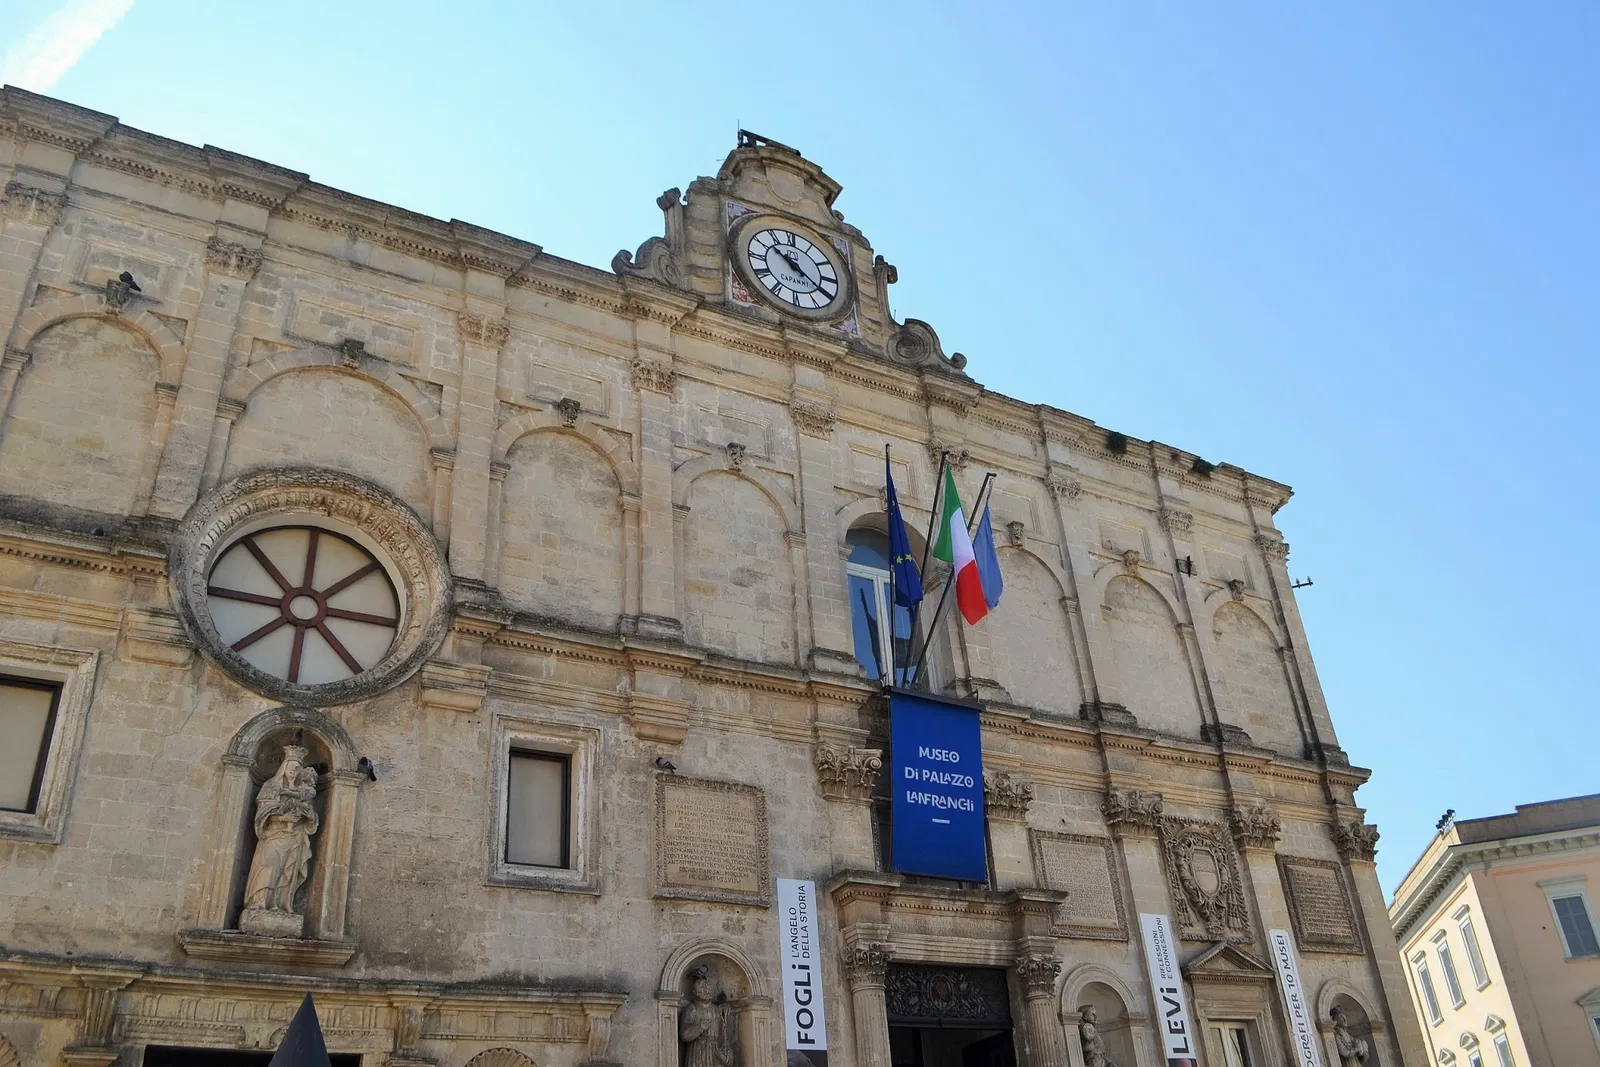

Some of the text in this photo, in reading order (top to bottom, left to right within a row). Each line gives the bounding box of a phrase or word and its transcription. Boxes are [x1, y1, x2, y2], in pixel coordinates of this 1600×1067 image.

[919, 746, 960, 763] MUSEO
[922, 770, 974, 788] PALAZZO
[788, 907, 799, 958] L'ANGELO
[798, 885, 810, 959] DELLA STORIA
[1152, 930, 1166, 979] RIFLESSIONI
[1155, 917, 1172, 972] CONNESSIONI
[1276, 935, 1292, 970] MUSEI
[1286, 975, 1296, 989] 10
[1291, 993, 1303, 1018] PER
